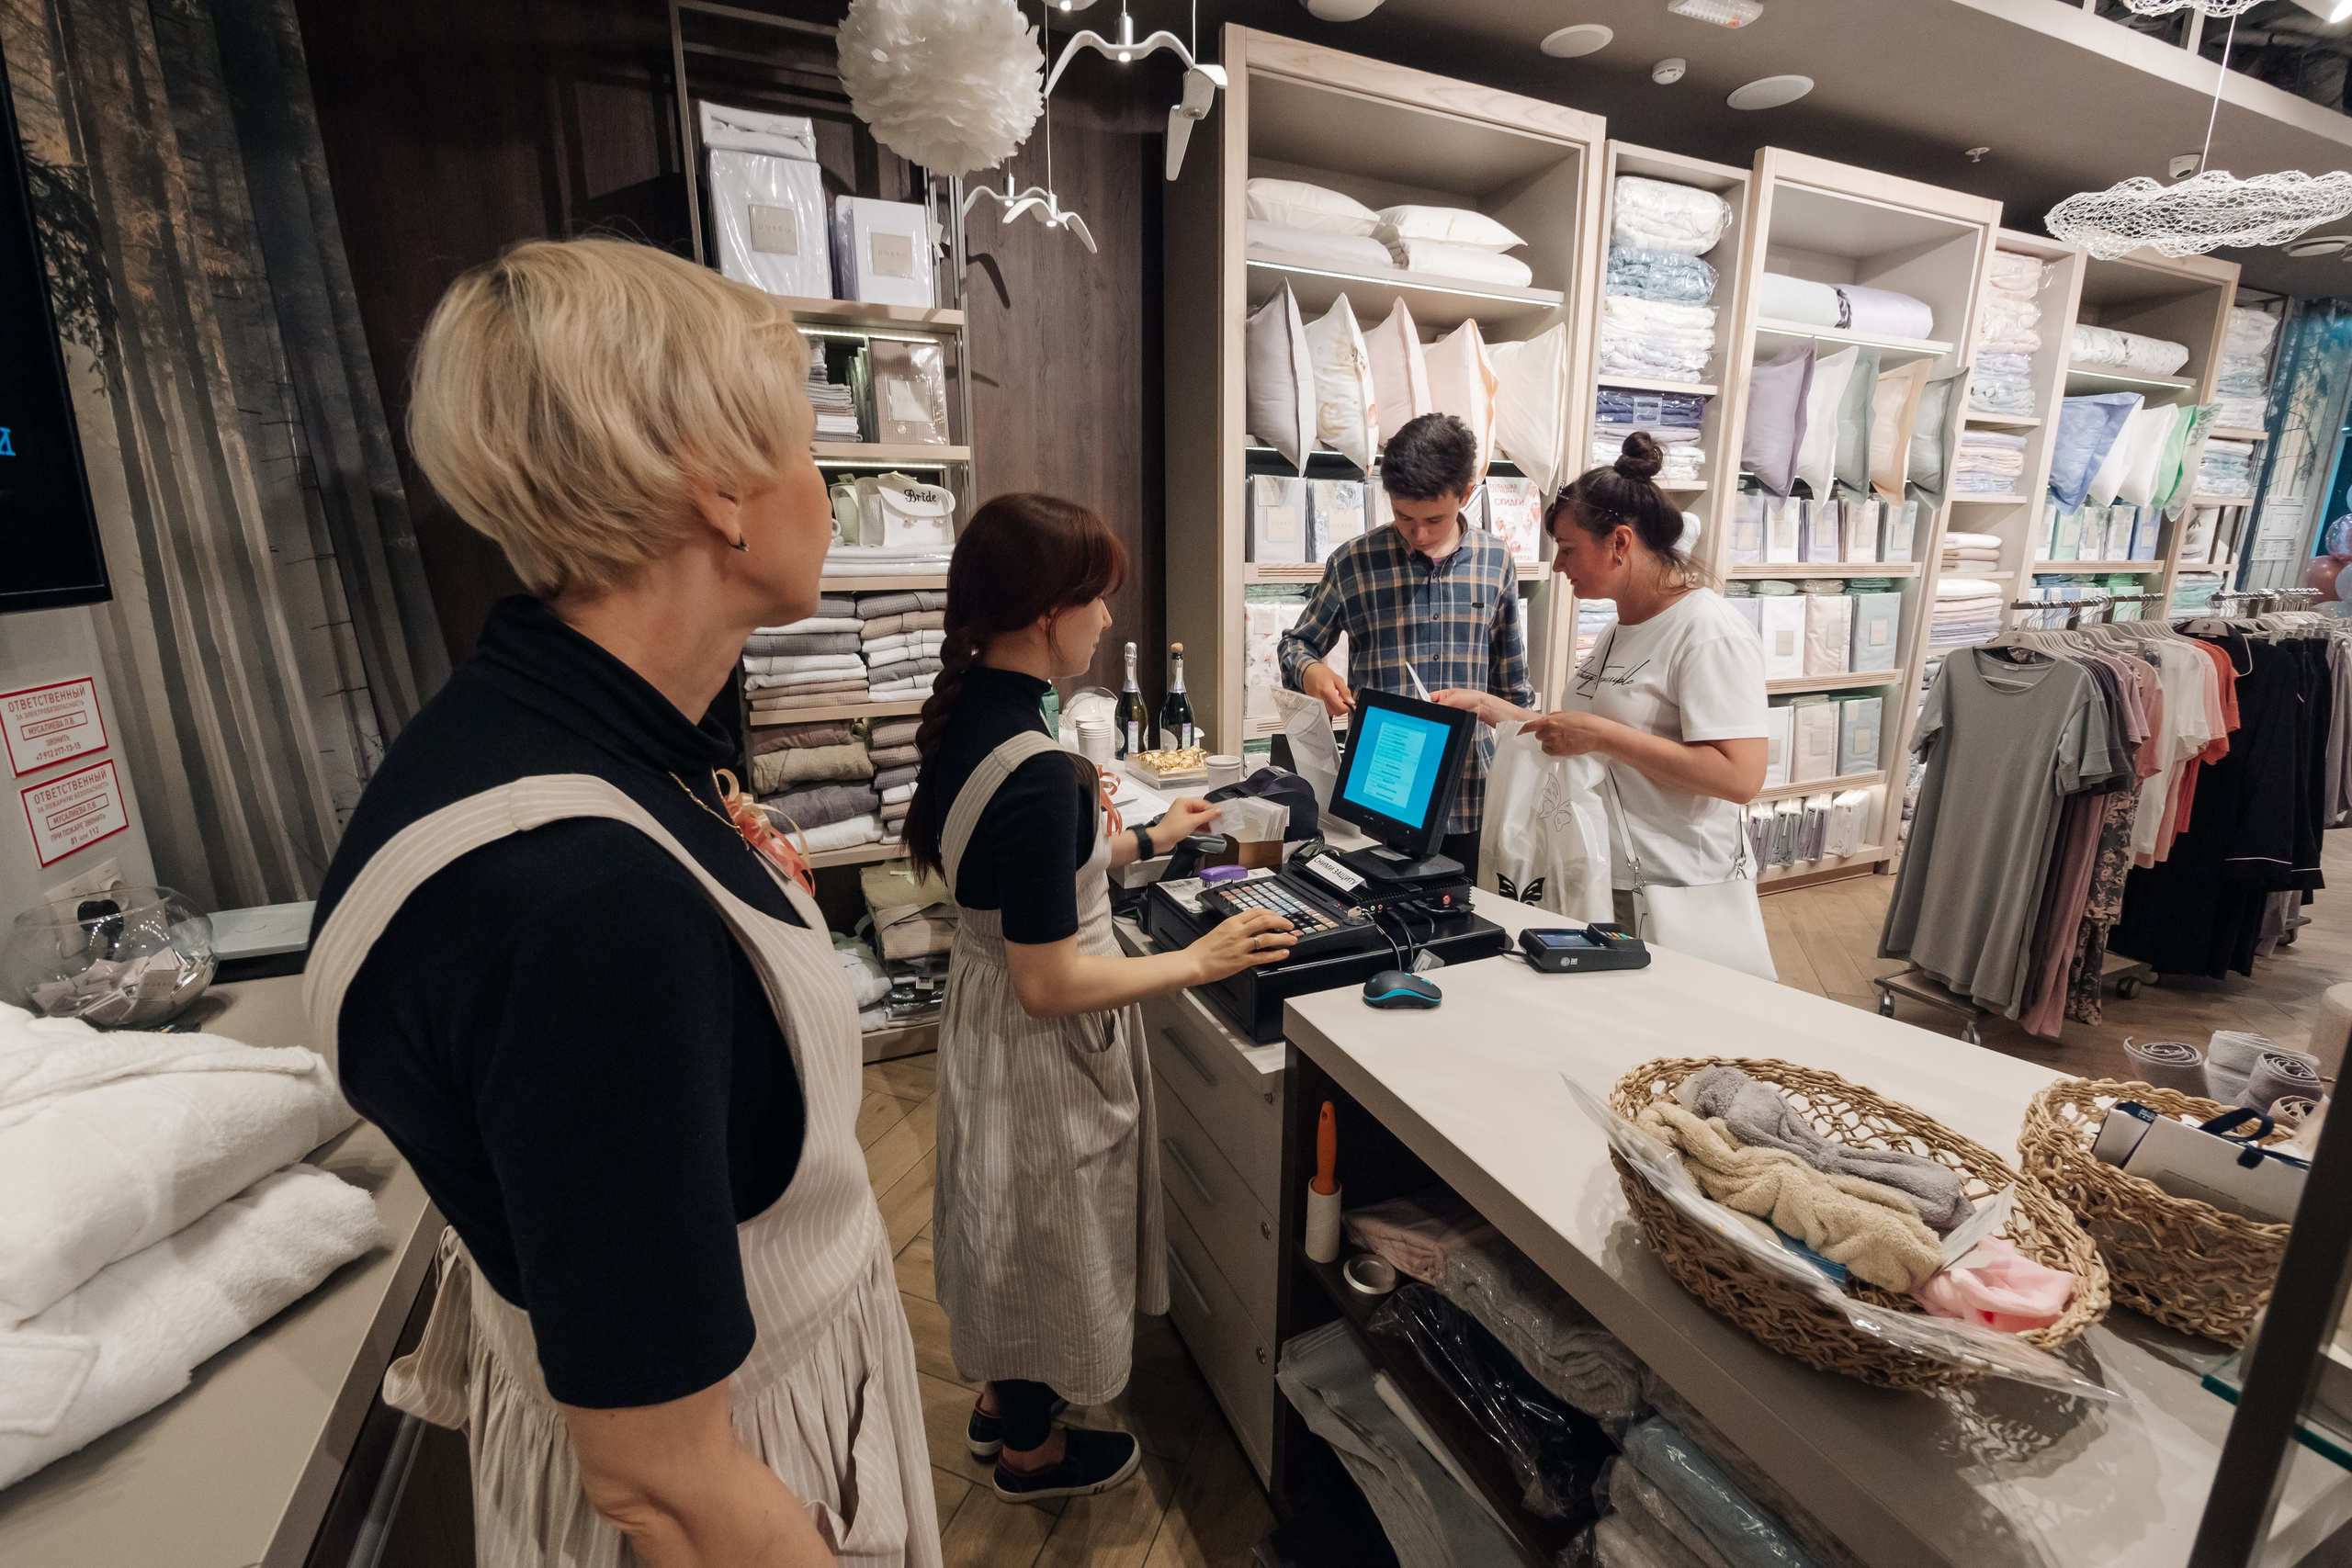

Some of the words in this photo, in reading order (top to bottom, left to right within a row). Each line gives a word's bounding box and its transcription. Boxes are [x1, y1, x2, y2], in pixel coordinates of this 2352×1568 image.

[904, 490, 936, 502] Bride
[1494, 498, 1525, 506] СКИДКИ
[8, 684, 86, 713] ОТВЕТСТВЕННЫЙ
[25, 700, 85, 719] ЭЛЕКТРОБЕЗОПАСНОСТЬ
[28, 720, 64, 735] МУСАЛИЕВА
[46, 734, 71, 747] ЗВОНИТЬ
[33, 768, 107, 805] ОТВЕТСТВЕННЫЙ
[45, 795, 74, 810] ПОЖАРНУЮ
[51, 831, 62, 841] ПРИ
[62, 821, 85, 835] ПОЖАРЕ
[1314, 857, 1335, 872] СНИМИ
[1332, 869, 1358, 885] ЗАЩИТУ
